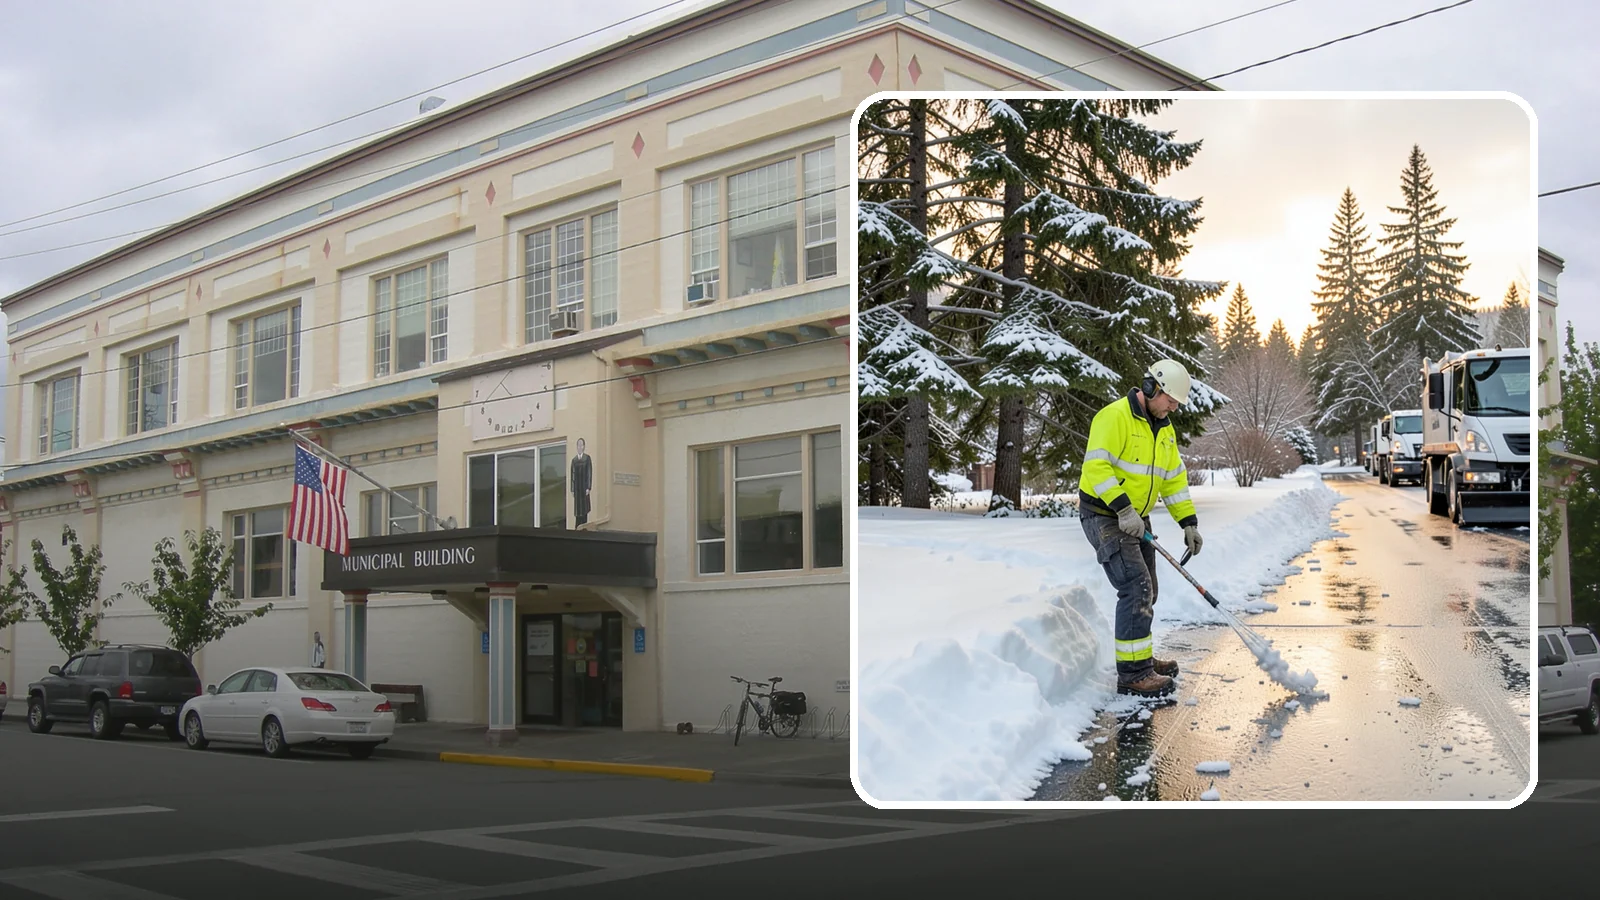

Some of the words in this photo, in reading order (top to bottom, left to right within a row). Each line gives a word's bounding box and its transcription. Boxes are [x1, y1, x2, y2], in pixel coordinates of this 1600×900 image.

[547, 362, 552, 370] 6
[536, 402, 540, 410] 4
[480, 407, 485, 415] 8
[488, 418, 492, 426] 9
[529, 414, 533, 422] 3
[521, 420, 526, 428] 2
[508, 425, 514, 433] 12
[342, 552, 405, 572] MUNICIPAL
[414, 546, 475, 567] BUILDING
